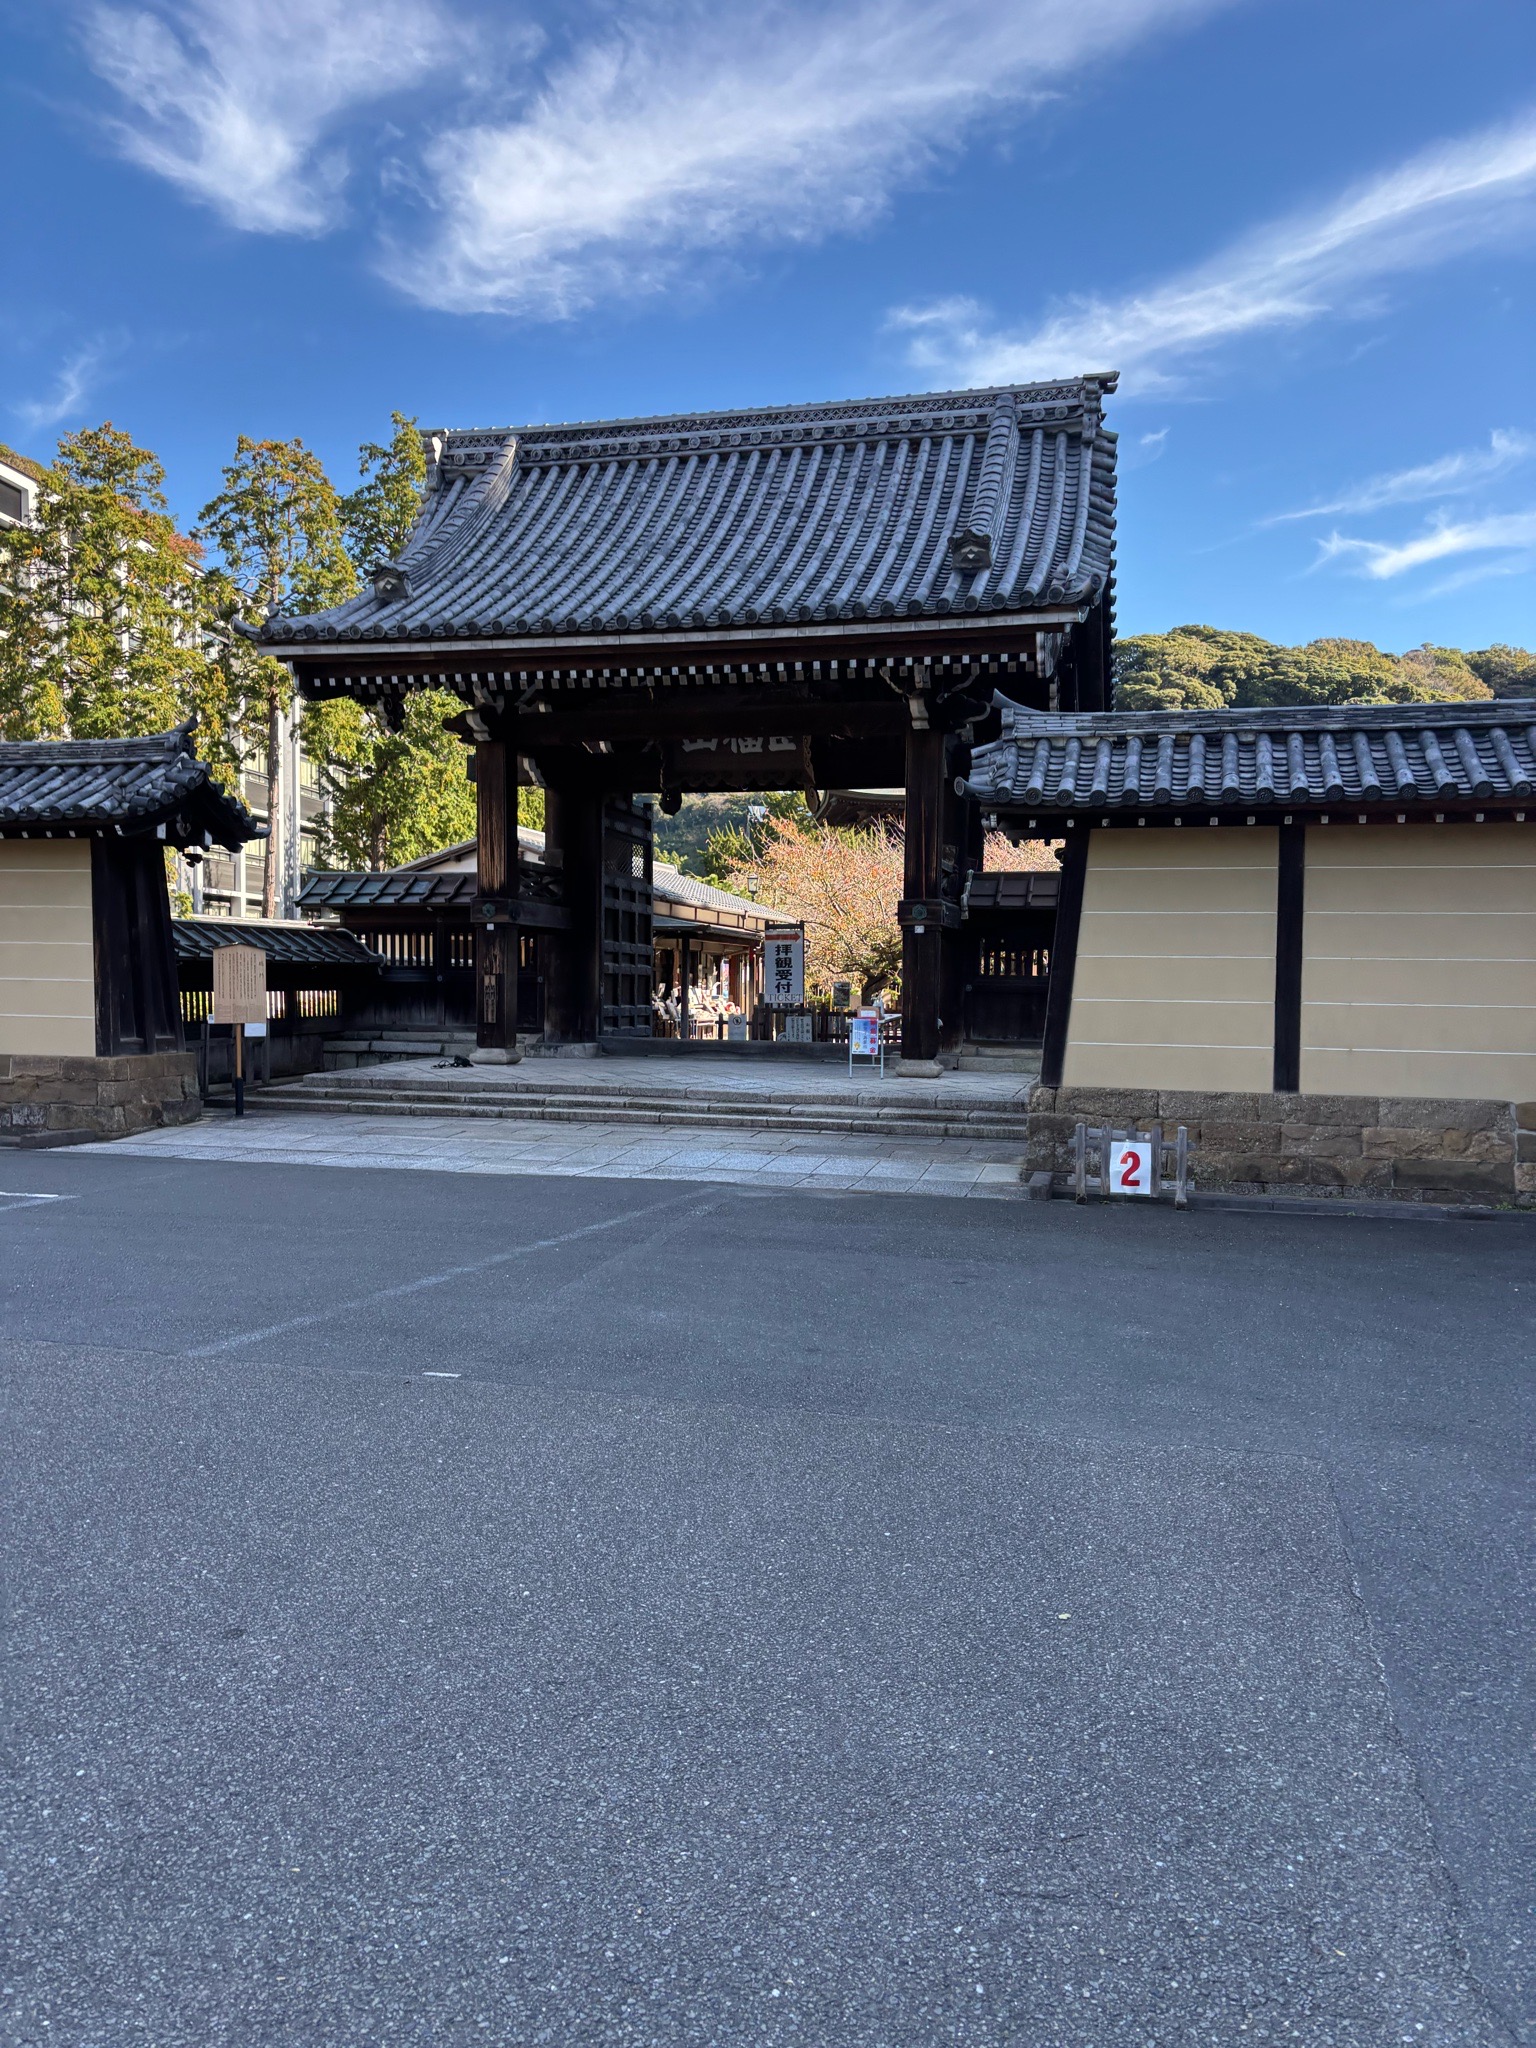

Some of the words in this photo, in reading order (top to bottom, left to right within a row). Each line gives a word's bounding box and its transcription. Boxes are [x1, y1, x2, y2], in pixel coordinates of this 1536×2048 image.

[775, 944, 792, 993] 拝観受付
[768, 994, 802, 1002] TICKET
[1120, 1151, 1140, 1186] 2
